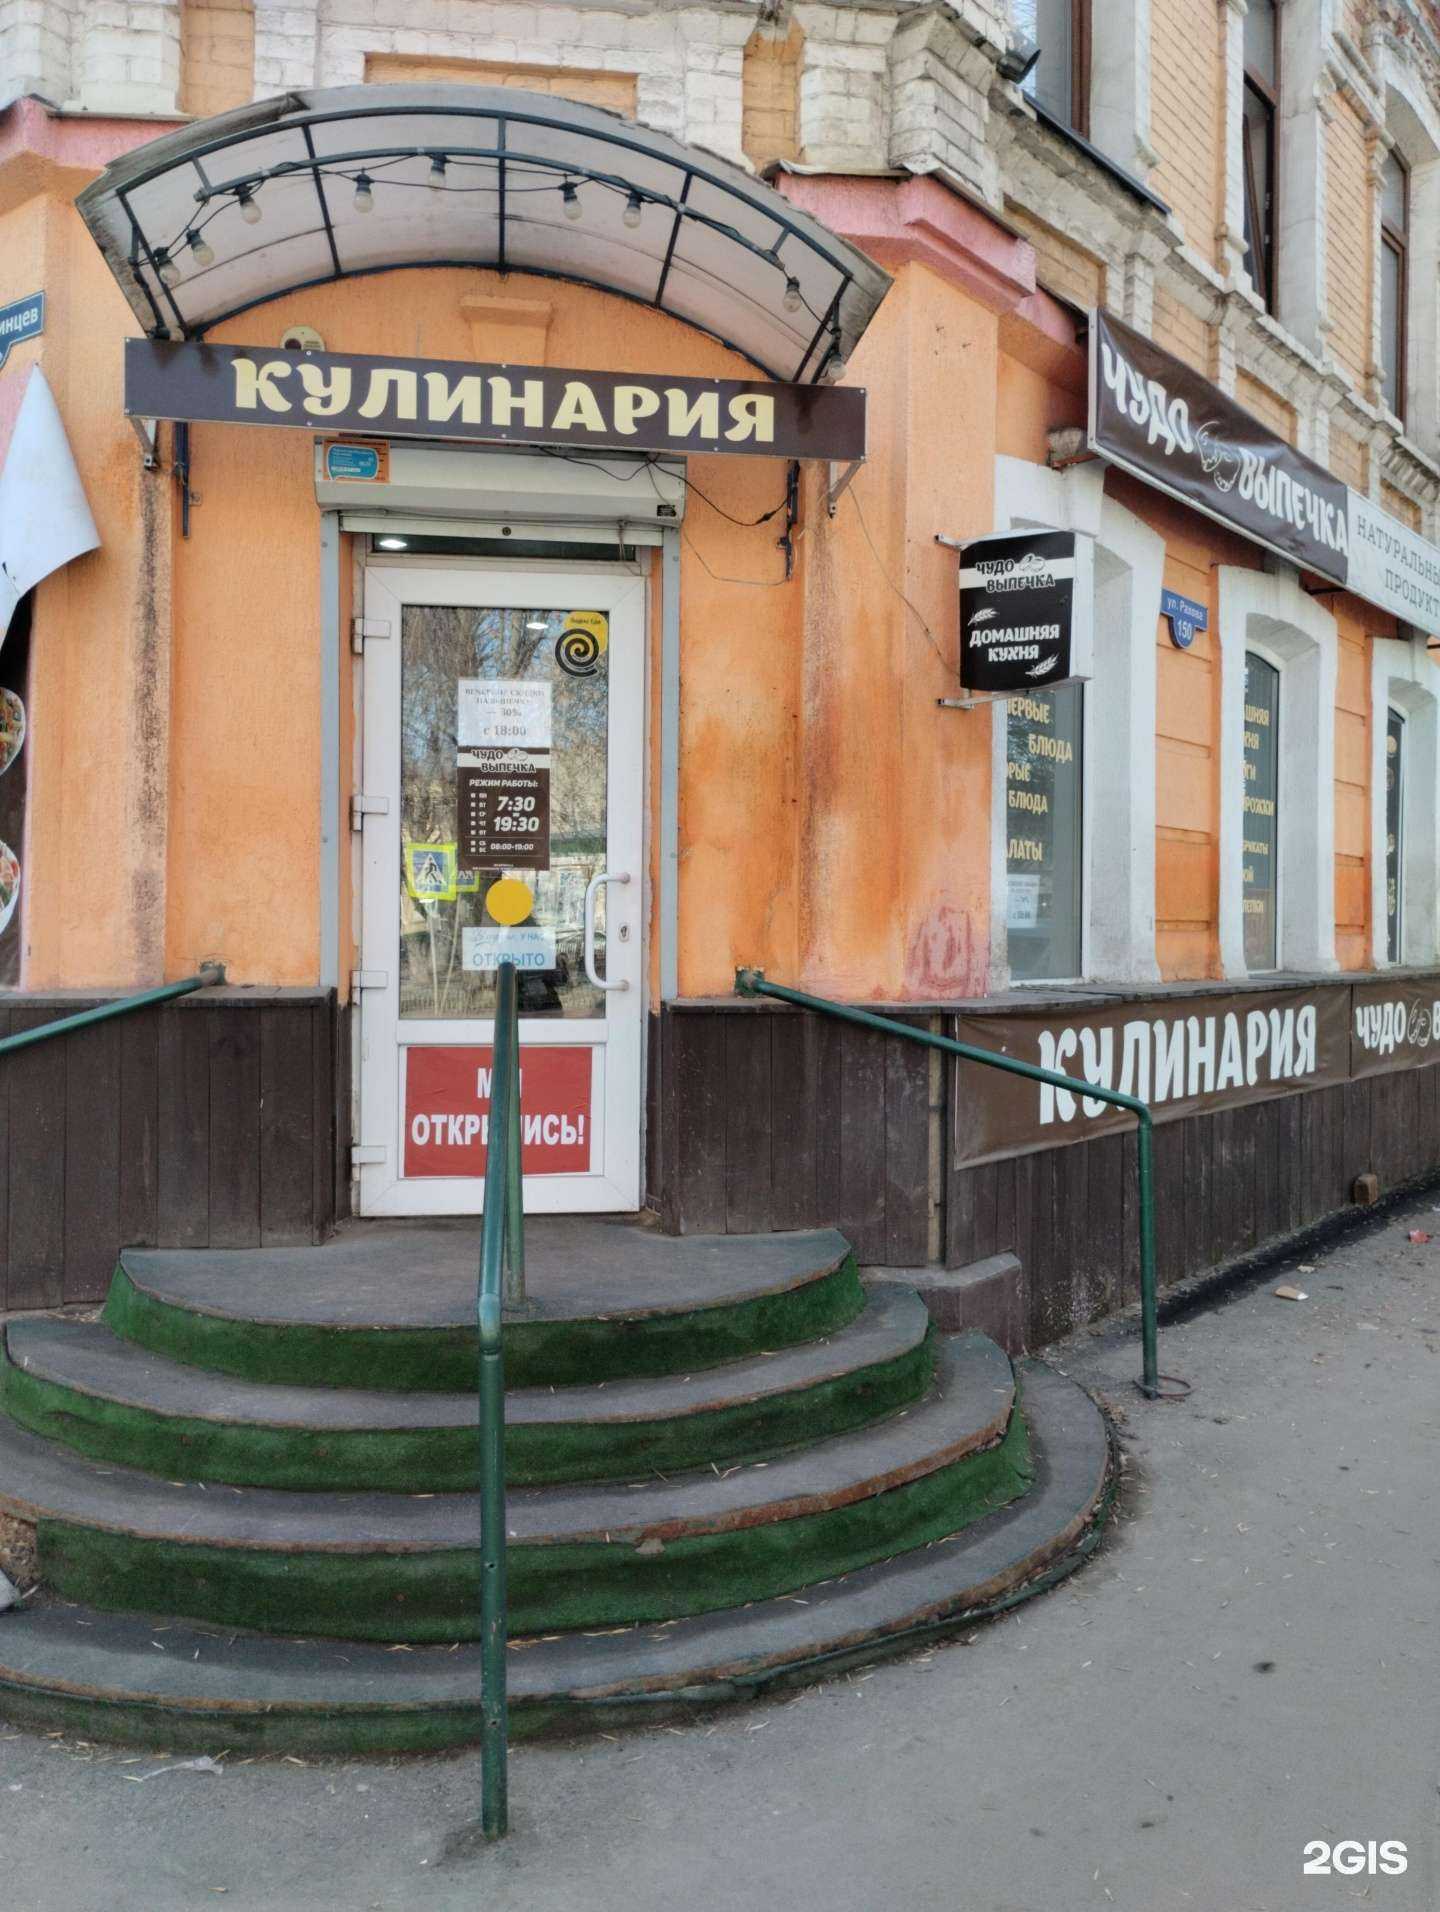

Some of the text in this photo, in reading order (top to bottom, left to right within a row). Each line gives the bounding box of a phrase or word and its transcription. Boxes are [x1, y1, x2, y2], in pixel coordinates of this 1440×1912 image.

[231, 357, 775, 442] КУЛИНАРИЯ
[1101, 342, 1194, 455] ЧУДО
[1238, 447, 1349, 557] ВЫПЕЧКА
[975, 559, 1015, 577] ЧУДО
[986, 573, 1056, 594] ВЫПЕЧКА
[969, 624, 1061, 648] ДОМАШНЯЯ
[1177, 619, 1193, 641] 150
[988, 645, 1040, 662] КУХНЯ
[495, 725, 527, 736] 18:00
[472, 749, 503, 761] ЧУДО
[1028, 733, 1073, 763] БЛЮДА
[481, 762, 536, 773] ВЫПЕЧКА
[469, 779, 538, 788] РЕЖИМ РАБОТЫ:
[497, 796, 536, 812] 7:30
[1008, 790, 1048, 815] БЛЮДА
[494, 816, 540, 832] 19:30
[1007, 838, 1043, 862] ЛАТЫ
[472, 952, 545, 967] ОТКРЫТО
[1356, 1001, 1406, 1055] ЧУДО
[1037, 1005, 1317, 1125] КУЛИНАРИЯ
[477, 1067, 523, 1099] М
[411, 1114, 585, 1146] ОТКРИСЬ!
